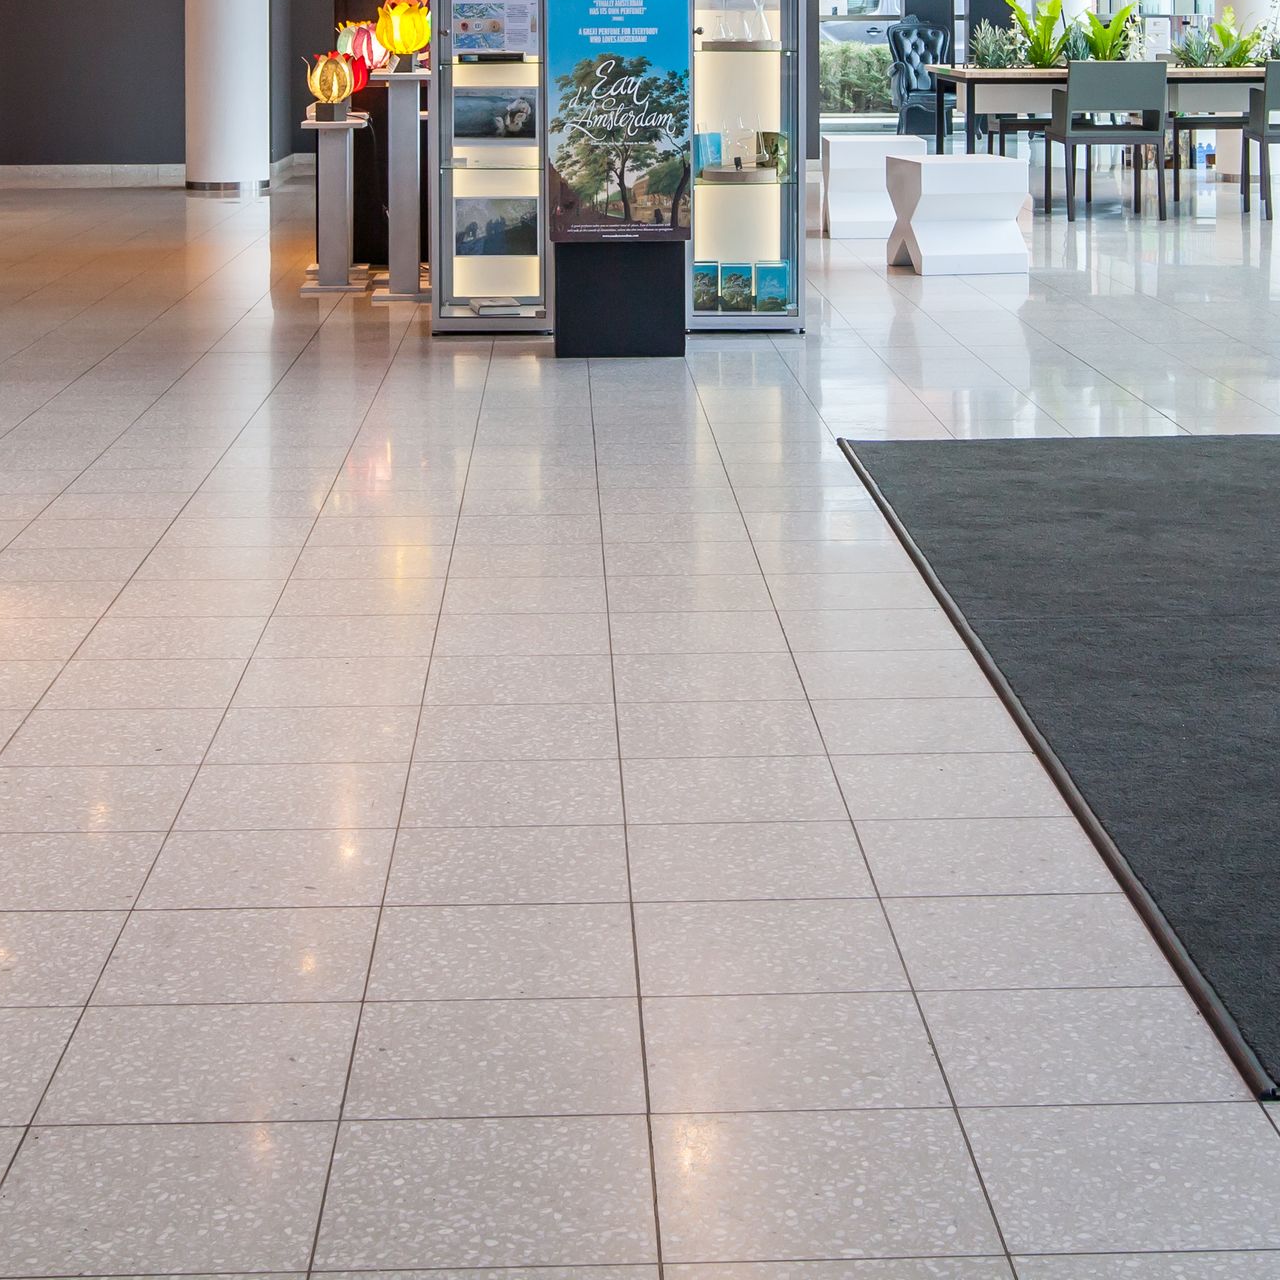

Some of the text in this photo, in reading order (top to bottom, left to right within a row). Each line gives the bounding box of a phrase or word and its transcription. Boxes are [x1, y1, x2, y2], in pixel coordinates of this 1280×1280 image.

[632, 27, 659, 35] EVERYBODY
[591, 59, 650, 105] Eau
[563, 98, 676, 141] Amsterdam
